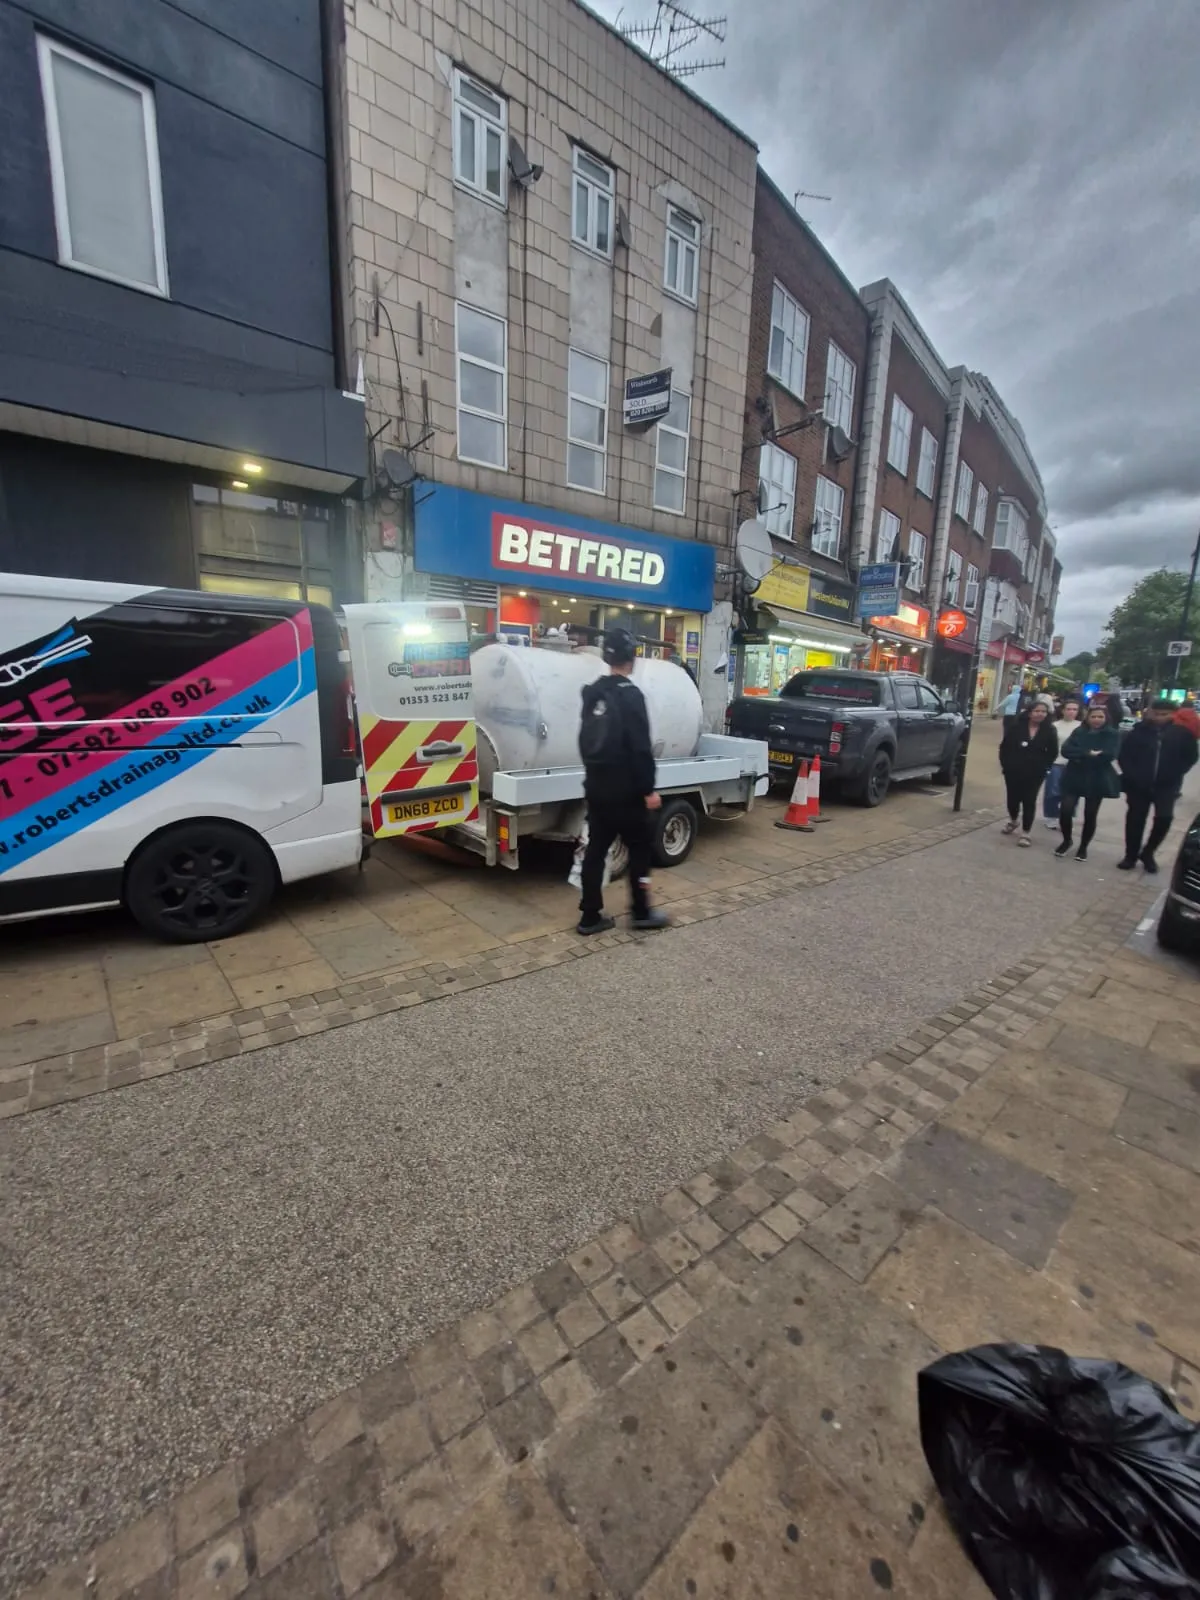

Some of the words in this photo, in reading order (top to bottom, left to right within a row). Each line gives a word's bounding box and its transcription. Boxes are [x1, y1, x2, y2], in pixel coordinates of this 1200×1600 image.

[630, 399, 647, 408] SOLD
[500, 523, 665, 586] BETFRED
[400, 695, 429, 706] 01353
[432, 693, 449, 703] 523
[452, 691, 469, 701] 847
[37, 727, 121, 776] 07592
[122, 701, 171, 733] 088
[171, 677, 217, 708] 902
[394, 802, 430, 819] DN68
[433, 798, 458, 813] ZCO
